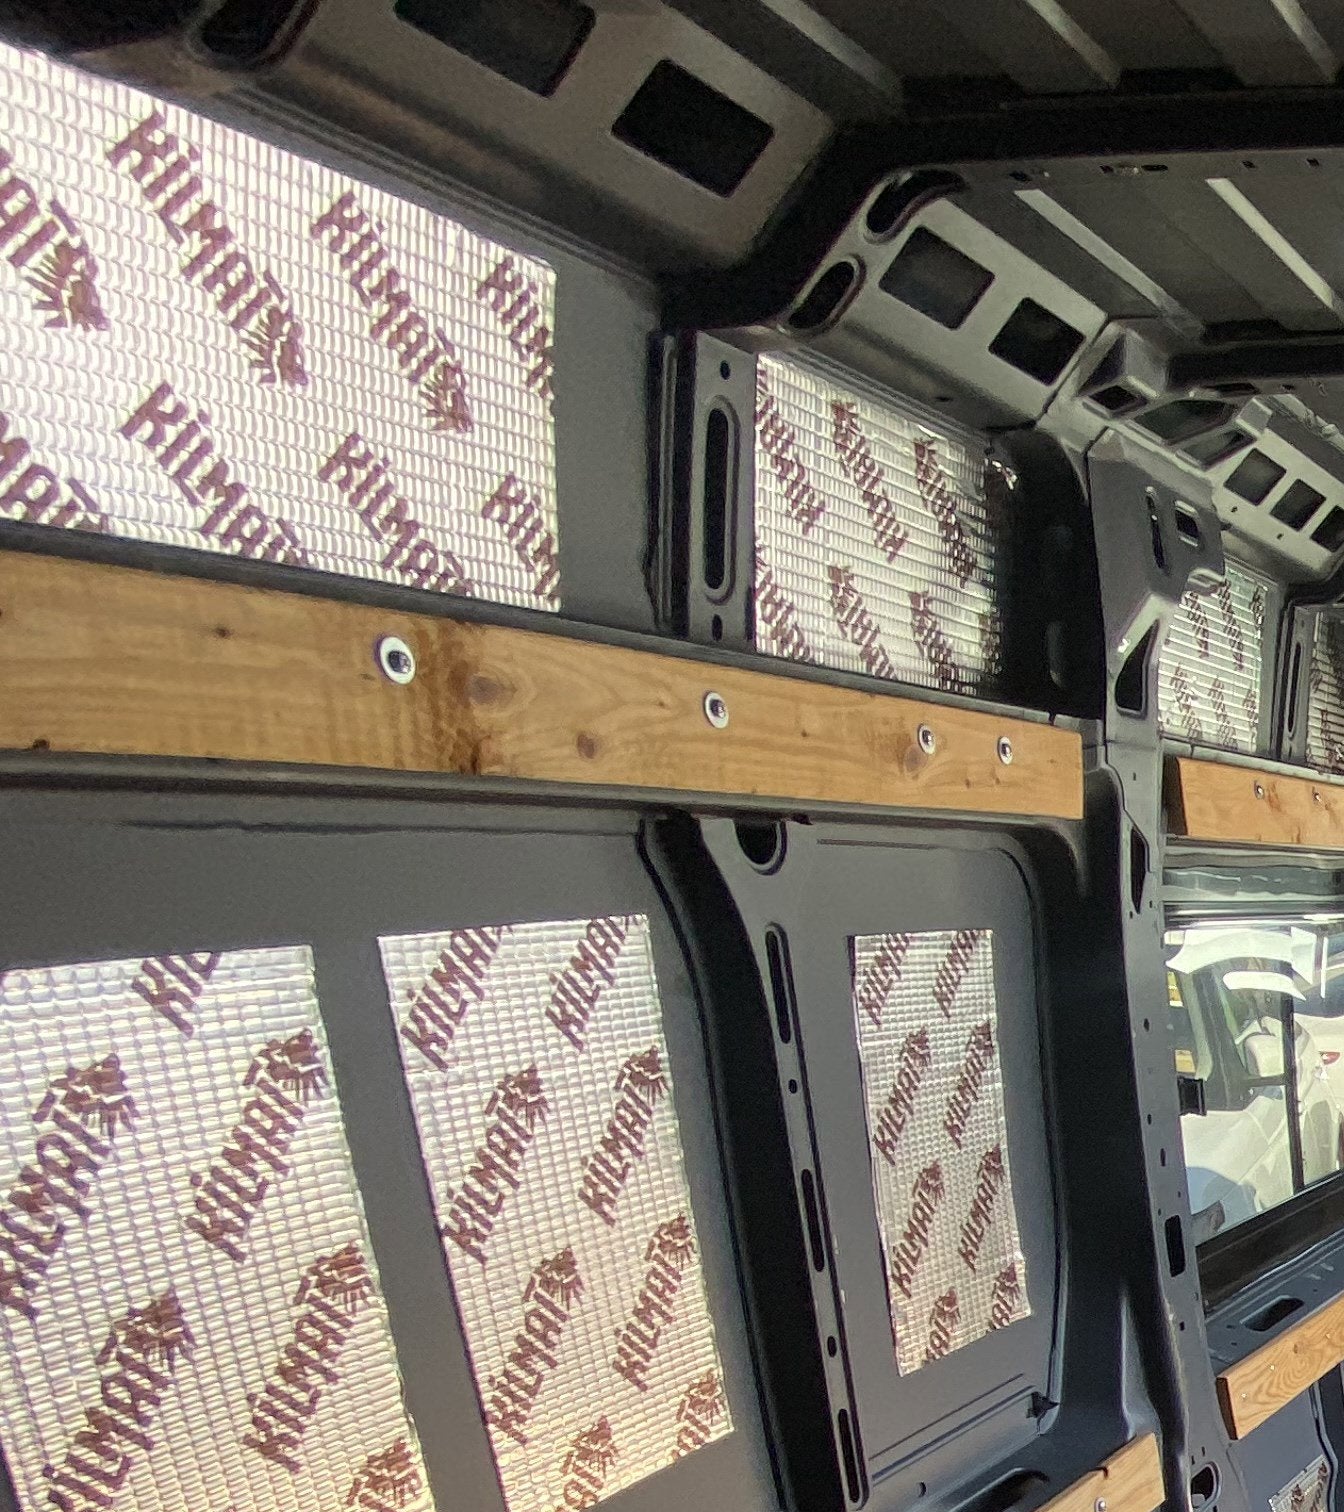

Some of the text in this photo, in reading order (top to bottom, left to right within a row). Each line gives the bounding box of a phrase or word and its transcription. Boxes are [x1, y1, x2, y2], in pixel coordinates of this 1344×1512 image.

[107, 112, 286, 332] KILMAT
[311, 191, 455, 385] KILMAT
[184, 1055, 305, 1263] KILMAT
[443, 1088, 534, 1264] KILMAT
[578, 1065, 654, 1226] KILMAT
[872, 1043, 924, 1166] KILMAT
[891, 1177, 938, 1298] KILMAT
[958, 1160, 995, 1272] KILMAT
[243, 1277, 355, 1472] KILMAT
[486, 1272, 571, 1445] KILMAT
[613, 1236, 685, 1391] KILMAT
